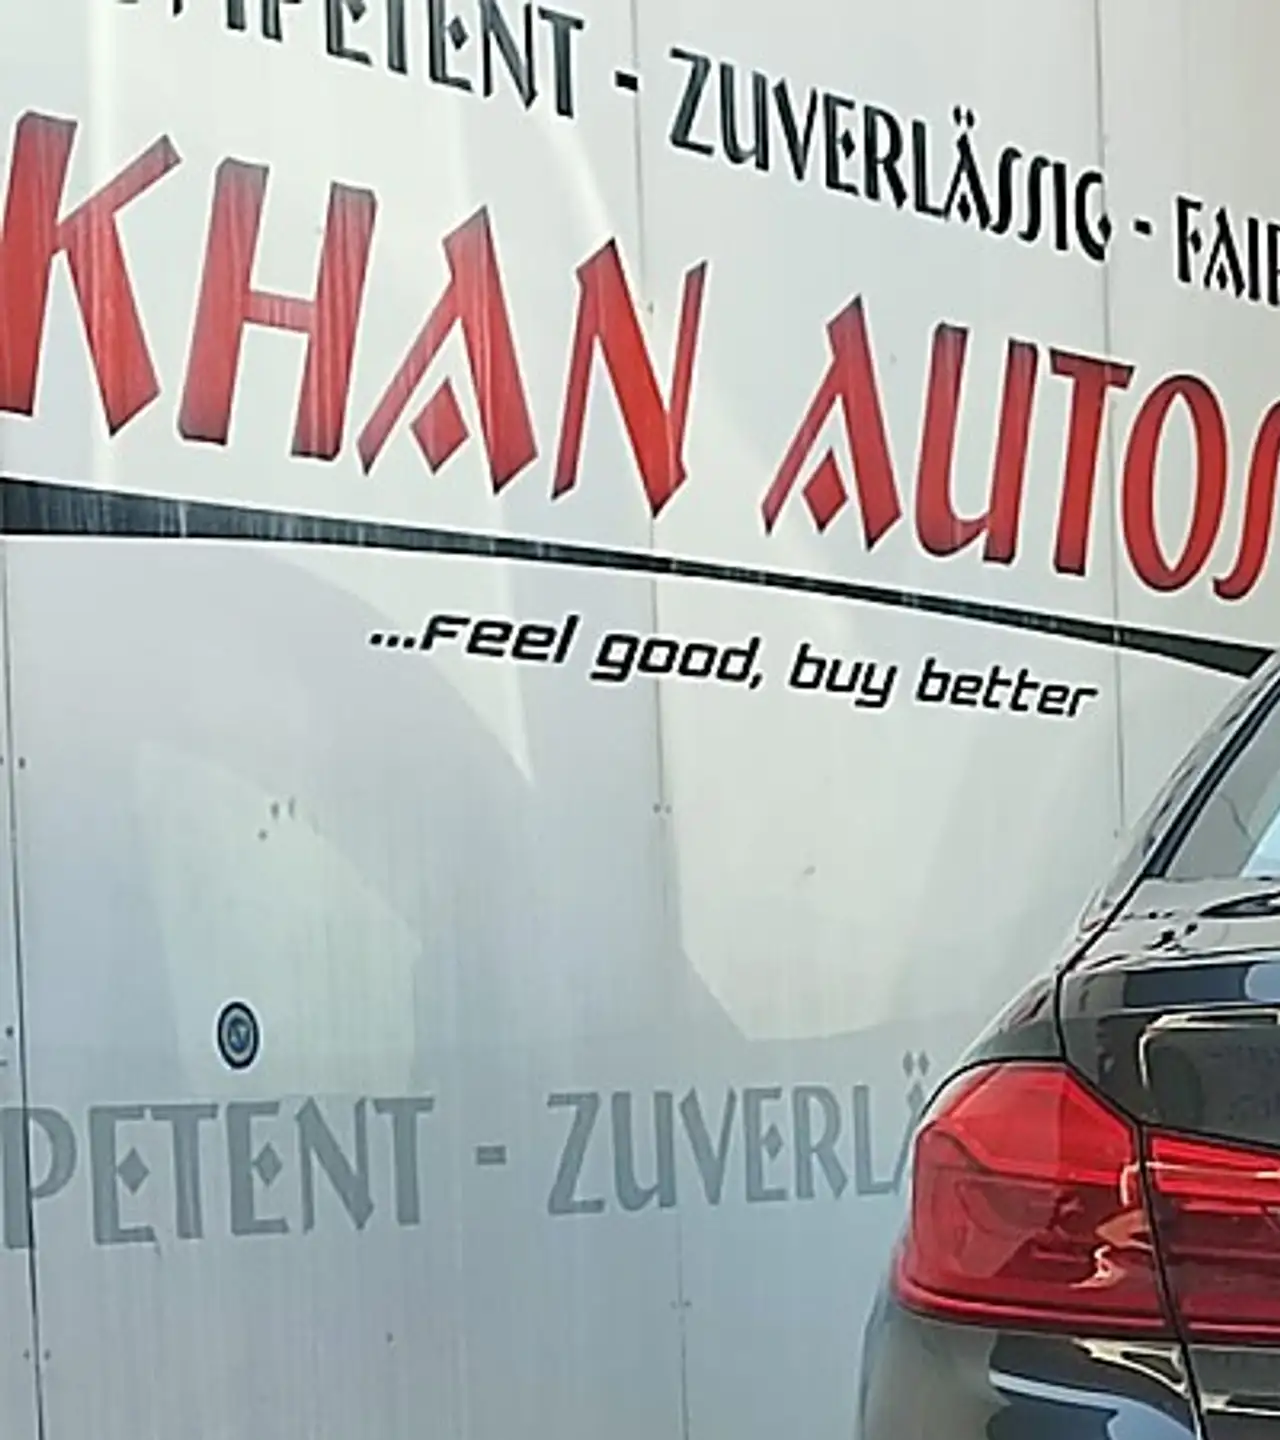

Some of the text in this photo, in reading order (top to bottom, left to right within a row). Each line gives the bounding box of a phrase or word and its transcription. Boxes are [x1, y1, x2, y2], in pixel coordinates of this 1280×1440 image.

[125, 0, 585, 119] ETENT
[669, 47, 1112, 261] ZUVERLÄSSIG
[0, 110, 708, 519] KHAN
[369, 614, 1099, 717] ...Feel good, buy better
[0, 1096, 435, 1250] PETENT
